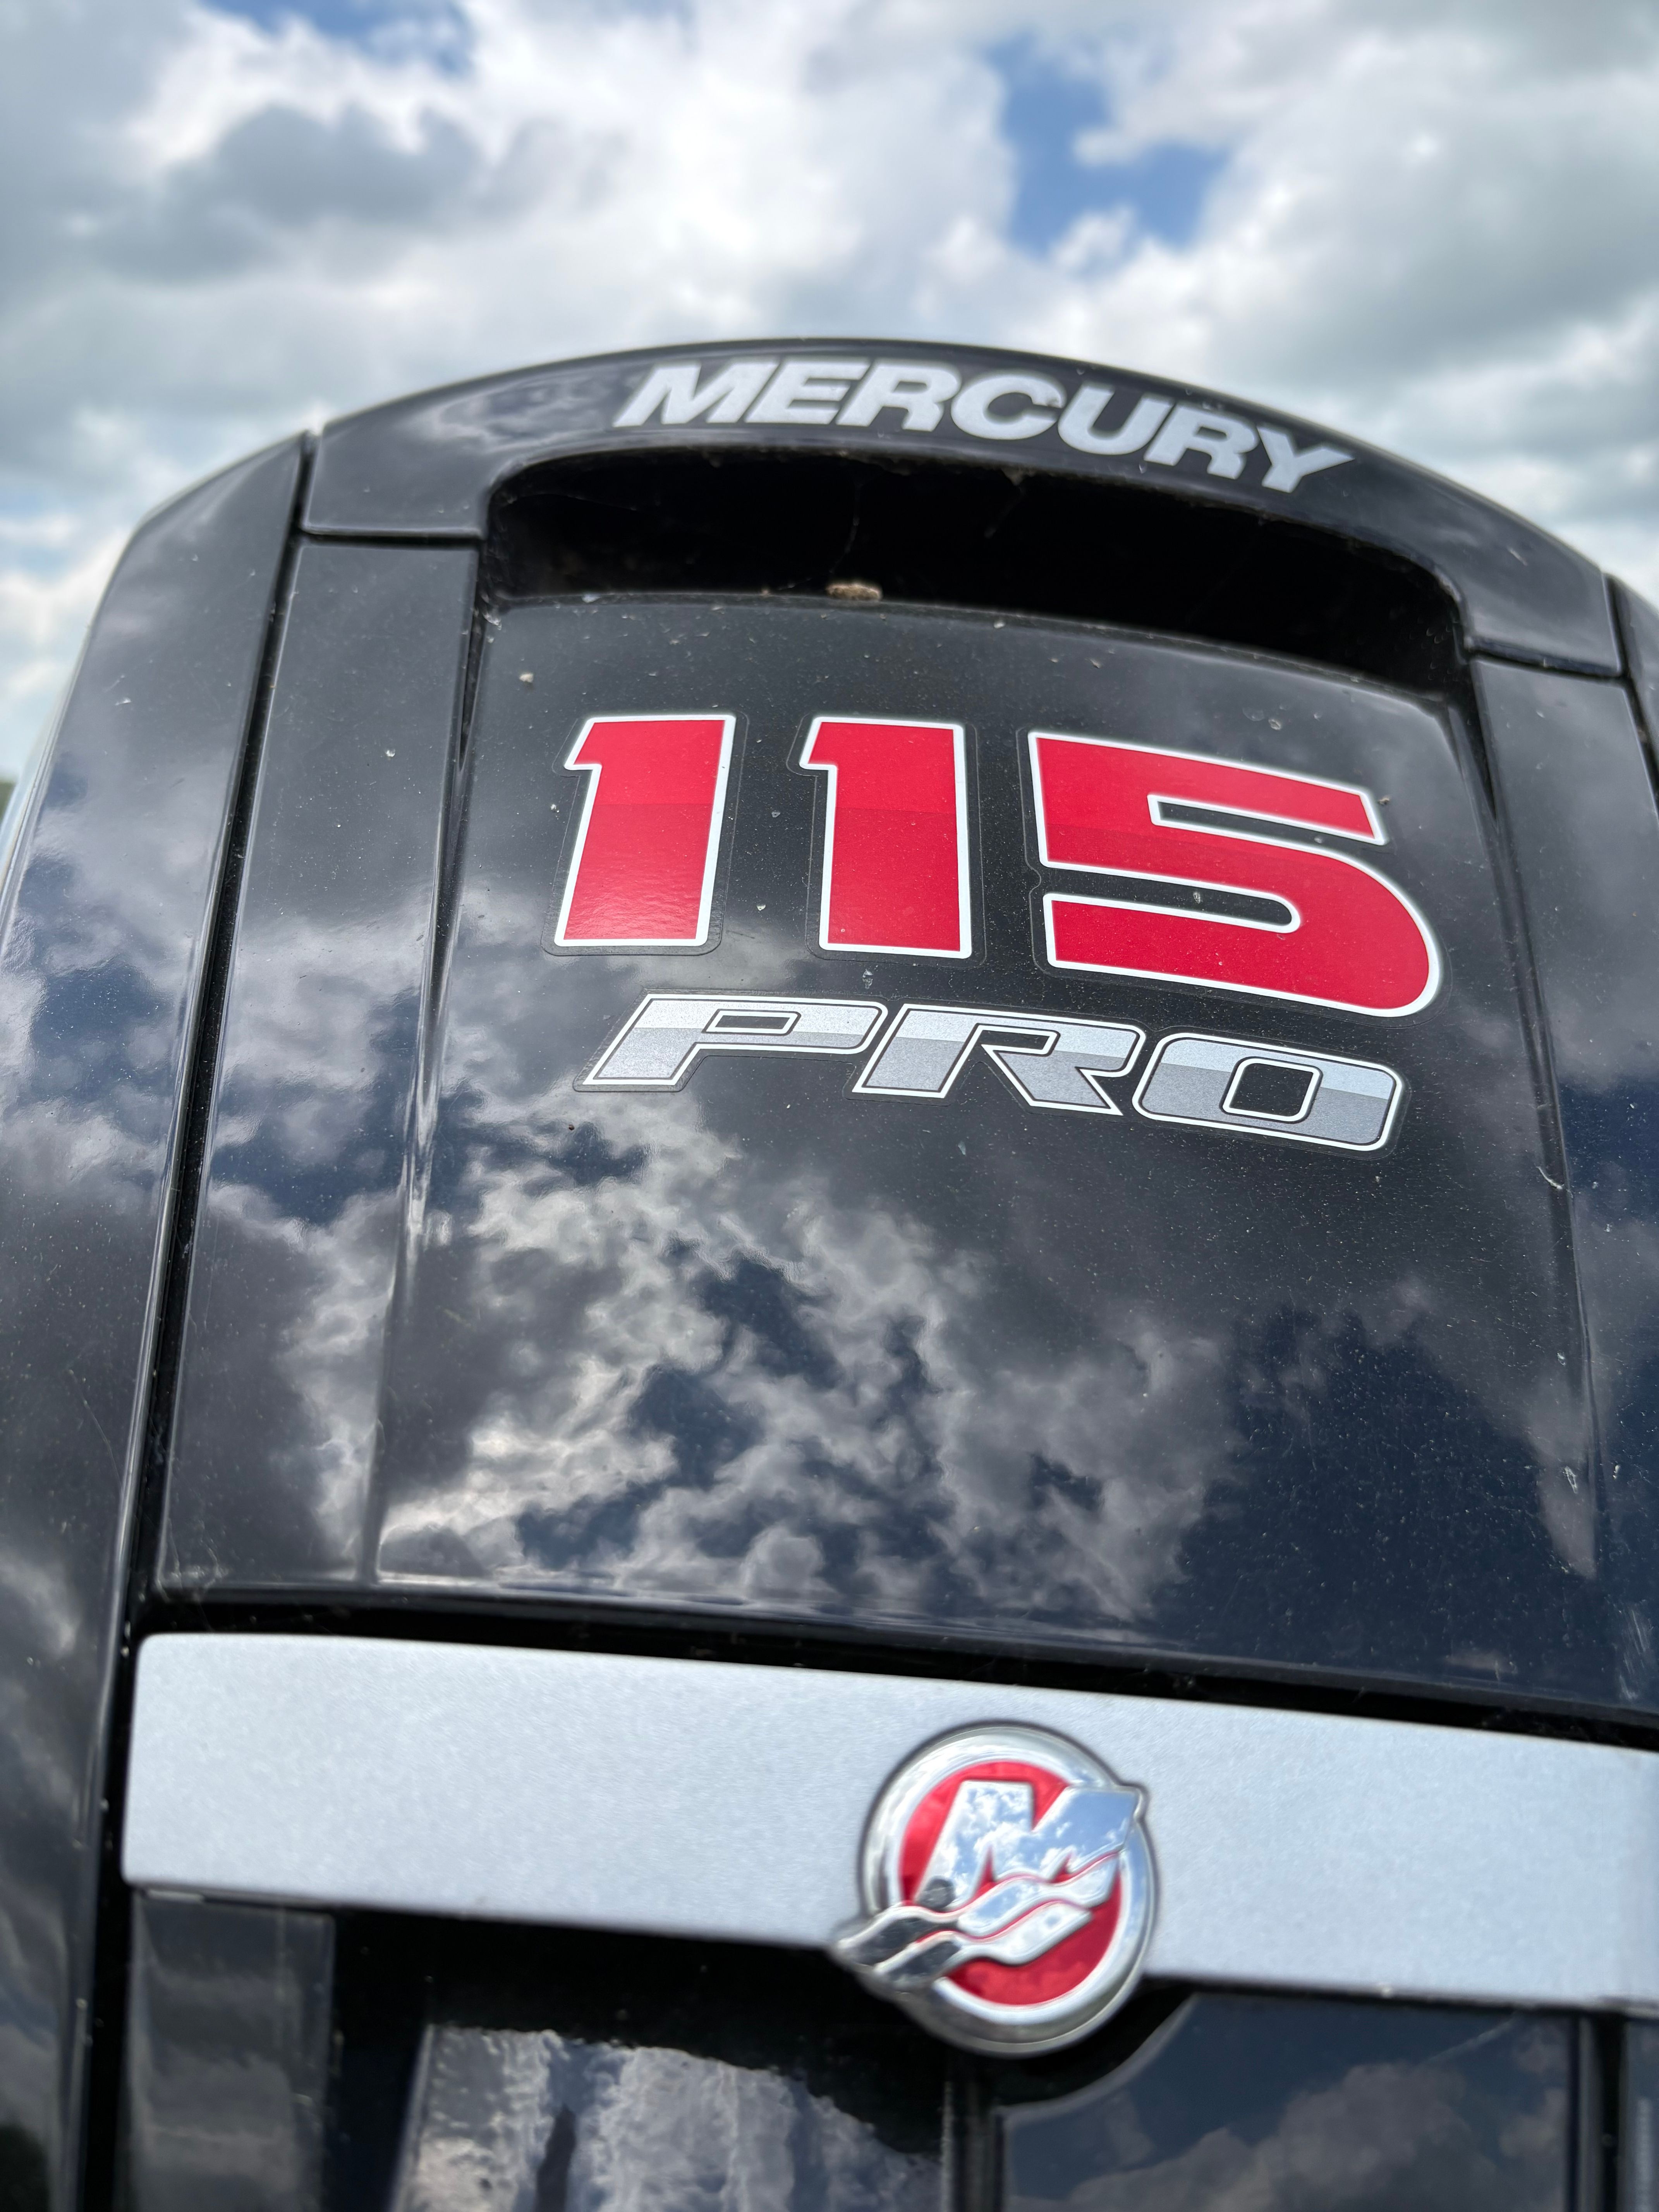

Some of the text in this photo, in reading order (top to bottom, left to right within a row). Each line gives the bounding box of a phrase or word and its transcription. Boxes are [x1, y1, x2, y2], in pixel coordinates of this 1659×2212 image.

[613, 358, 1355, 494] MERCURY
[553, 714, 1442, 1018] 115
[582, 993, 1405, 1154] PRO
